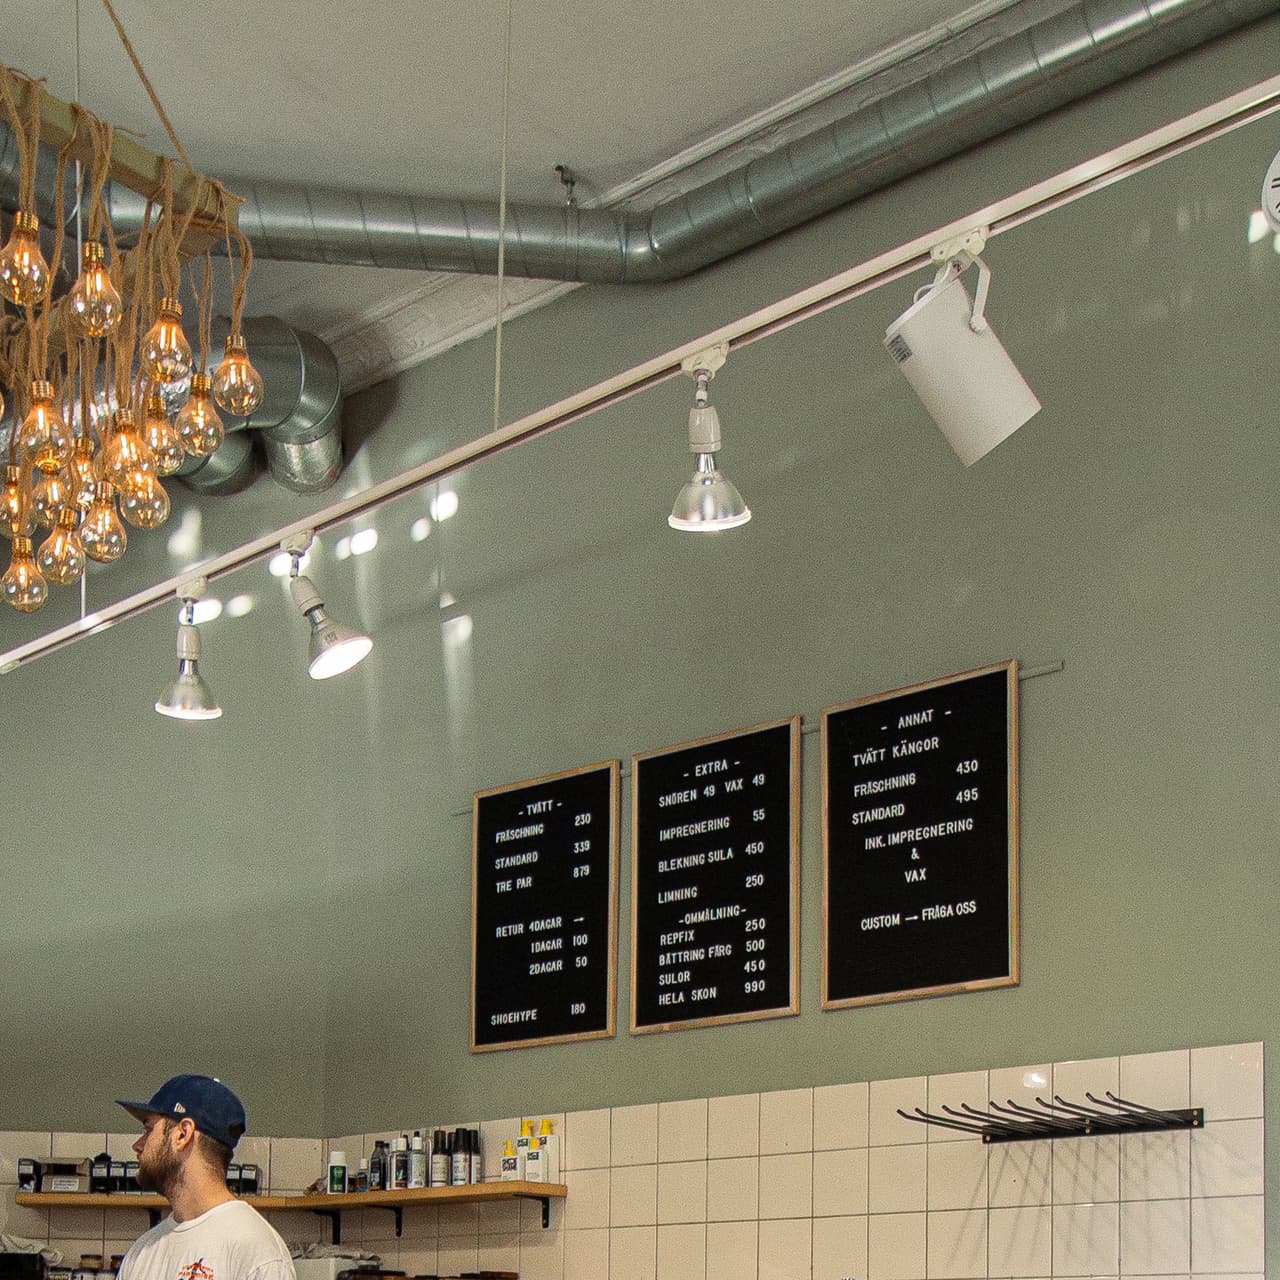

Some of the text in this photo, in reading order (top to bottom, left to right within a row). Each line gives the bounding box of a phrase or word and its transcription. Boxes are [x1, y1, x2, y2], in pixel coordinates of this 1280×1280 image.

[898, 709, 933, 728] ANNAT
[853, 737, 938, 766] TVÄTT KÄNGOR
[696, 760, 728, 776] EXTRA
[957, 760, 978, 774] 430
[704, 785, 715, 797] 49
[725, 779, 742, 792] VAX
[753, 774, 764, 786] 49
[852, 788, 978, 825] STANDARD 495
[575, 813, 590, 826] 230
[660, 809, 765, 841] IMPREGNERING 55
[865, 818, 973, 850] INK. IMPREGNERING
[495, 852, 538, 869] STANDARD
[659, 842, 764, 872] BLEKNING SULA 450
[911, 848, 919, 859] &
[496, 865, 589, 893] TRE PAR 879
[905, 868, 926, 883] VAX
[658, 874, 763, 903] LIMNING 250
[861, 901, 976, 930] CUSTOM FRÅGA OSS
[496, 924, 523, 937] RETUR
[573, 934, 587, 946] 100
[661, 919, 765, 945] REPFIX 250
[746, 939, 765, 952] 500
[576, 956, 587, 967] 50
[659, 960, 765, 985] SULOR 450
[659, 980, 765, 1005] HELA SKON 990
[491, 1003, 585, 1025] SHOEHYPE 180
